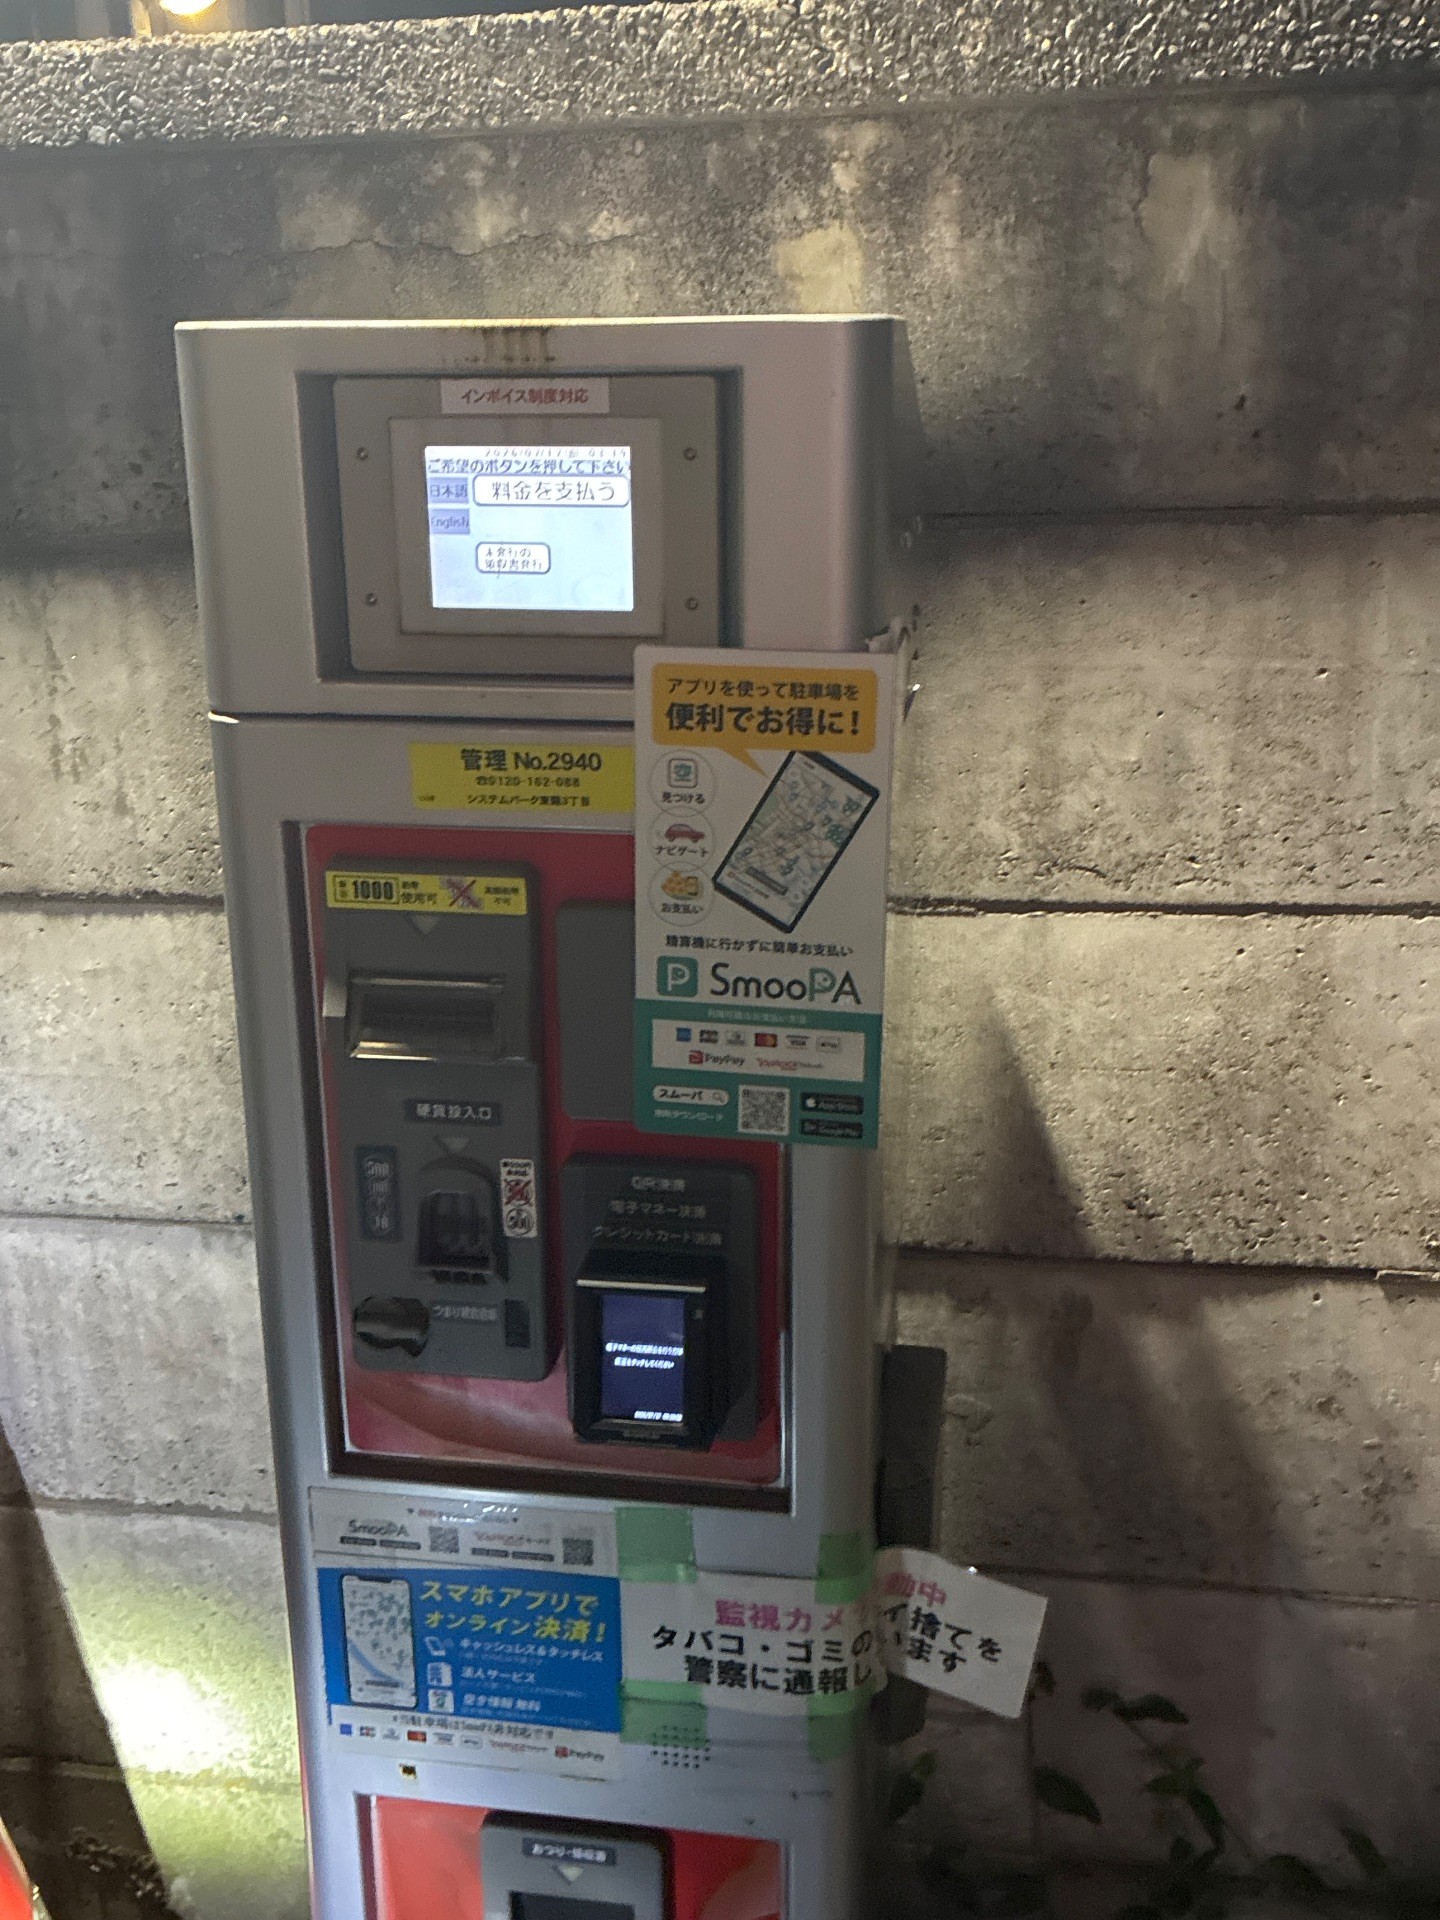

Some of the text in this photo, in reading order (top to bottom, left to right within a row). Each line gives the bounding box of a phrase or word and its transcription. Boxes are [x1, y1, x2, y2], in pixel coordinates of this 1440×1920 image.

[461, 387, 589, 405] インボイス制度対応
[428, 458, 632, 475] ご希望のボタンを押して下さい
[430, 484, 468, 498] 日本語
[492, 482, 615, 501] 料金を支払う
[431, 515, 469, 529] English
[668, 678, 859, 701] アプリを使って駐車場を
[461, 749, 602, 771] 管理 No.2940
[661, 791, 705, 804] 見つける
[656, 846, 709, 858] ナビゲート
[352, 880, 394, 900] 1000
[665, 934, 853, 957] 精算機に行かずに簡単お支払い
[710, 962, 862, 1005] SmooPA
[704, 1053, 746, 1067] PayPay
[421, 1581, 600, 1616] スマホアプリで
